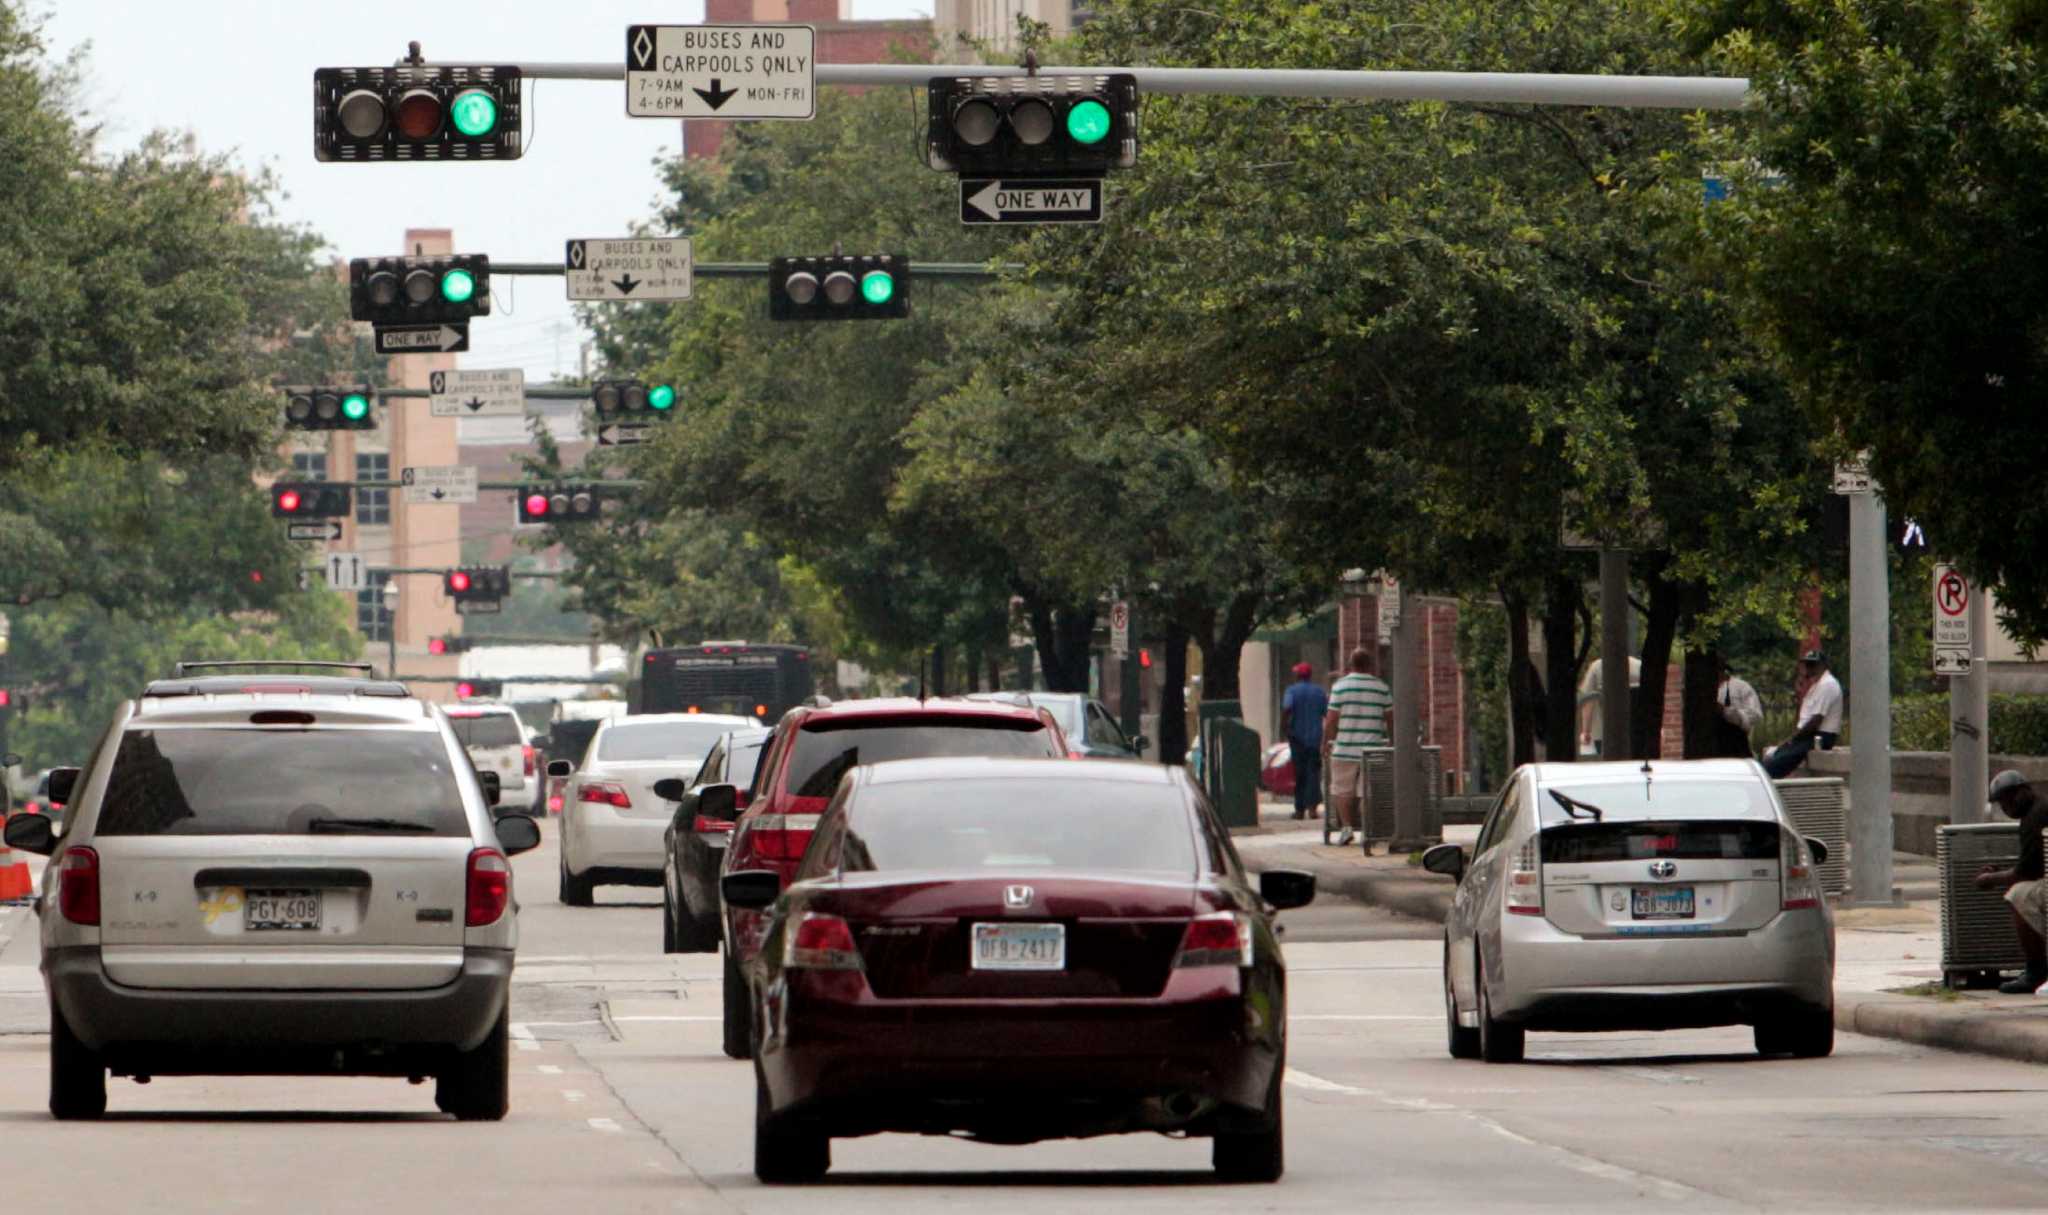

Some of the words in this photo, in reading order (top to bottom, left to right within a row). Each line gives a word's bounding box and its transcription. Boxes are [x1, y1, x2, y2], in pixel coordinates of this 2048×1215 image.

[684, 32, 742, 49] BUSES
[751, 32, 785, 49] AND
[662, 55, 754, 73] CARPOOLS
[762, 55, 807, 74] ONLY
[639, 78, 684, 92] 7-9AM
[747, 87, 805, 101] MON-FRI
[639, 97, 684, 110] 4-6PM
[995, 192, 1036, 209] ONE
[1043, 191, 1085, 208] WAY
[604, 242, 643, 254] BUSES
[649, 242, 672, 254] AND
[590, 258, 652, 270] CARPOOLS
[657, 258, 686, 271] ONLY
[386, 334, 409, 346] ONE
[416, 333, 440, 345] WAY
